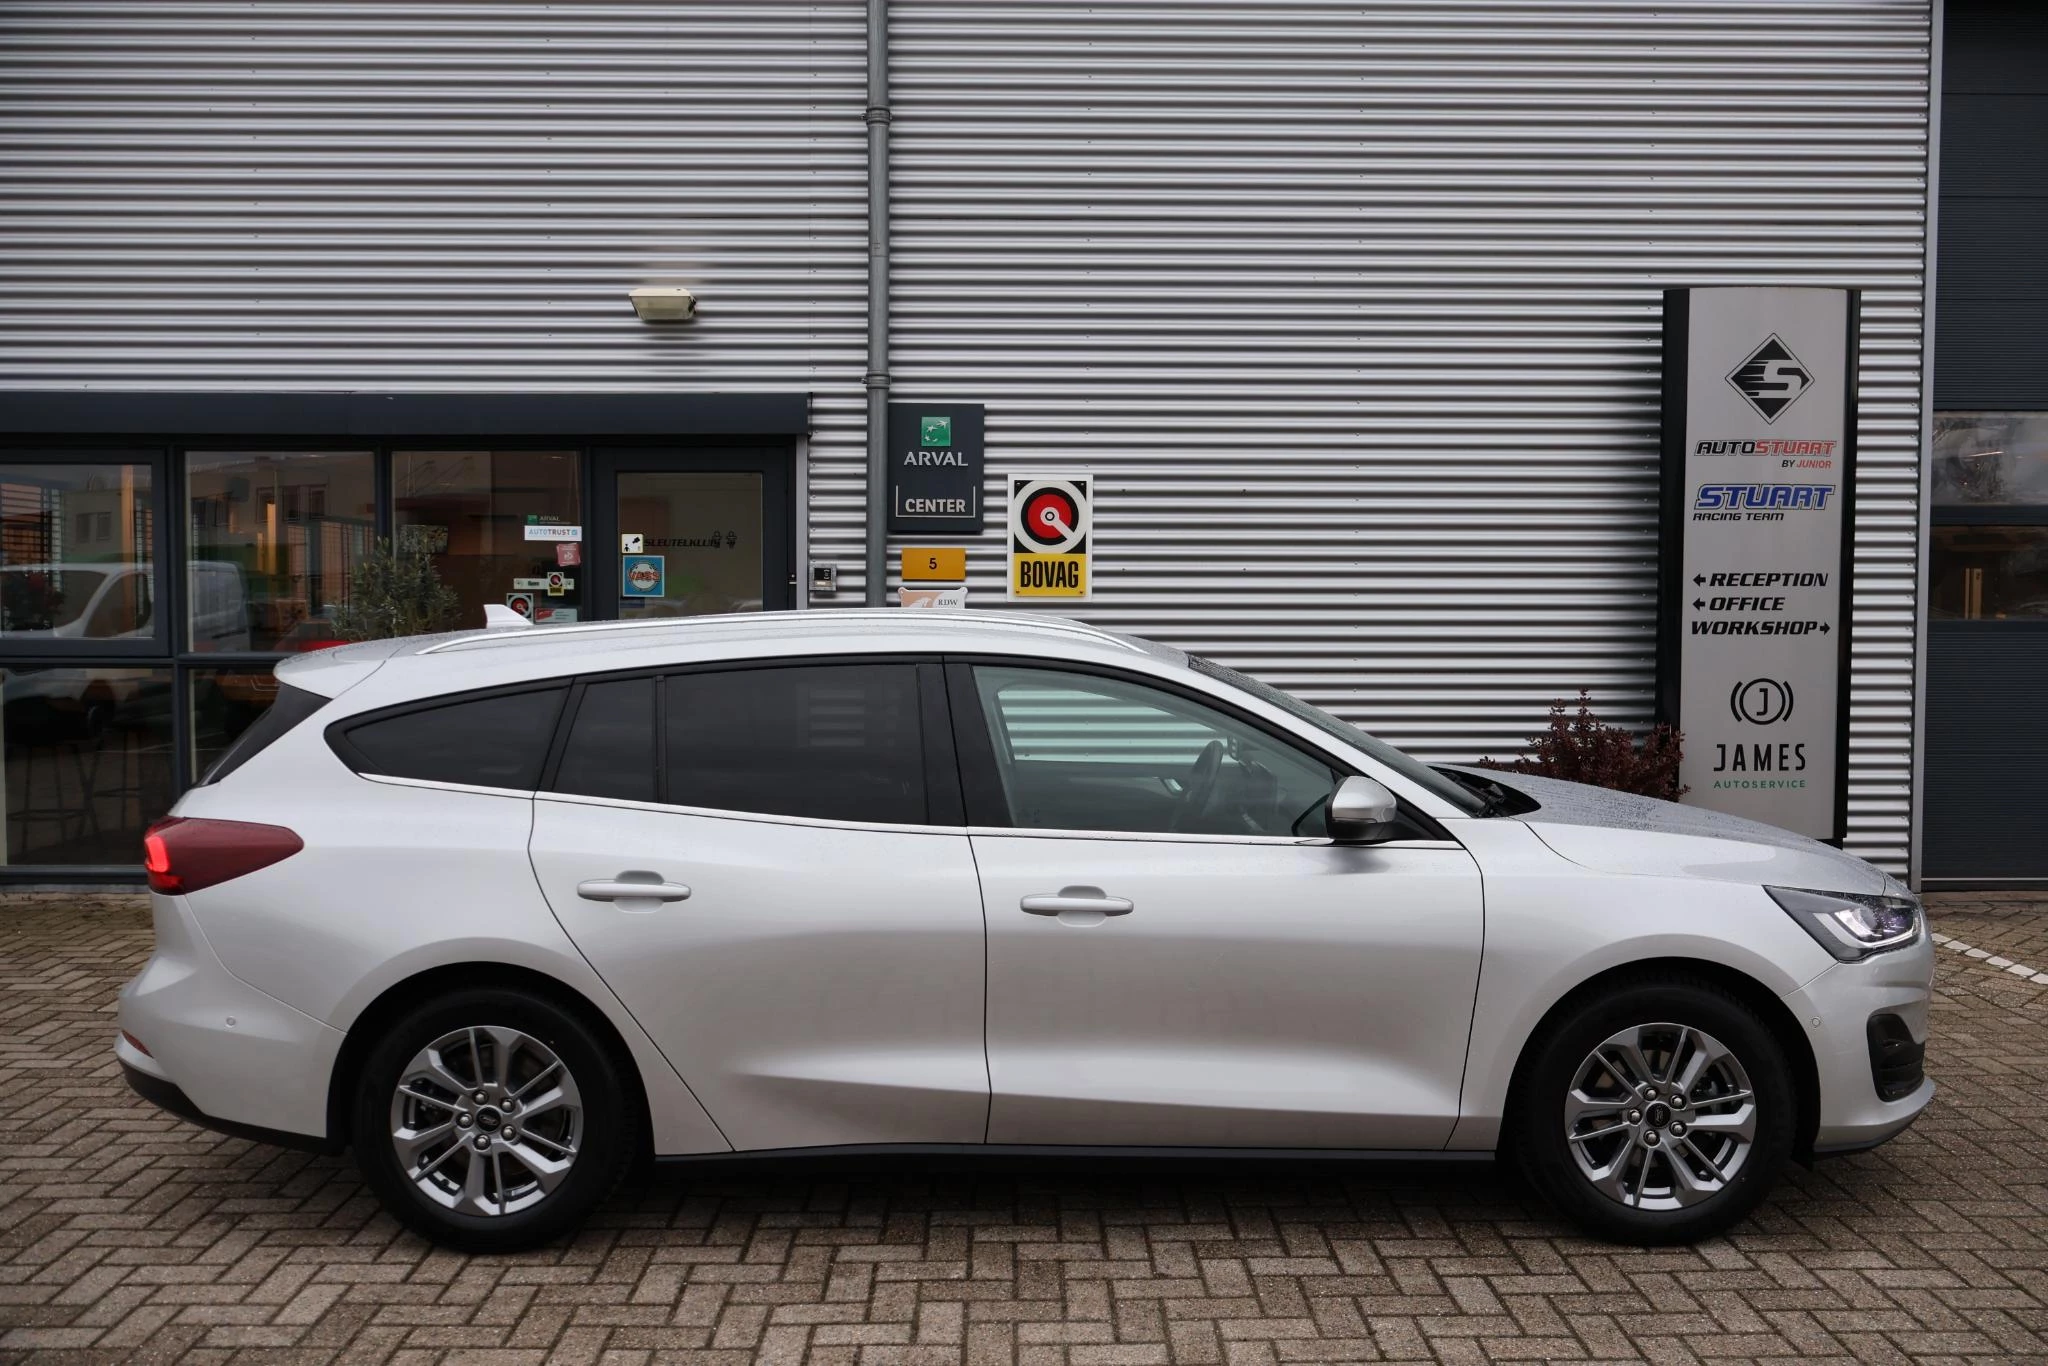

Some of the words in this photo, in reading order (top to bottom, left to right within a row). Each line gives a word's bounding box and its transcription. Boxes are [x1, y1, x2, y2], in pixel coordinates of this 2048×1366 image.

[1694, 440, 1837, 457] AUTOSTUART
[903, 451, 969, 467] ARVAL
[1781, 459, 1795, 468] BY
[1796, 460, 1832, 469] JUNIOR
[1694, 483, 1836, 510] STUART
[904, 498, 966, 513] CENTER
[1692, 512, 1742, 521] RACING
[1745, 512, 1785, 521] TEAM
[528, 528, 571, 536] AUTOTRUST
[928, 557, 938, 570] 5
[1020, 560, 1079, 588] BOVAG
[1709, 572, 1829, 587] RECEPTION
[1709, 596, 1786, 611] OFFICE
[1691, 620, 1818, 635] WORKSHOP
[1713, 743, 1806, 772] JAMES
[1713, 779, 1807, 789] AUTOSERVICE
